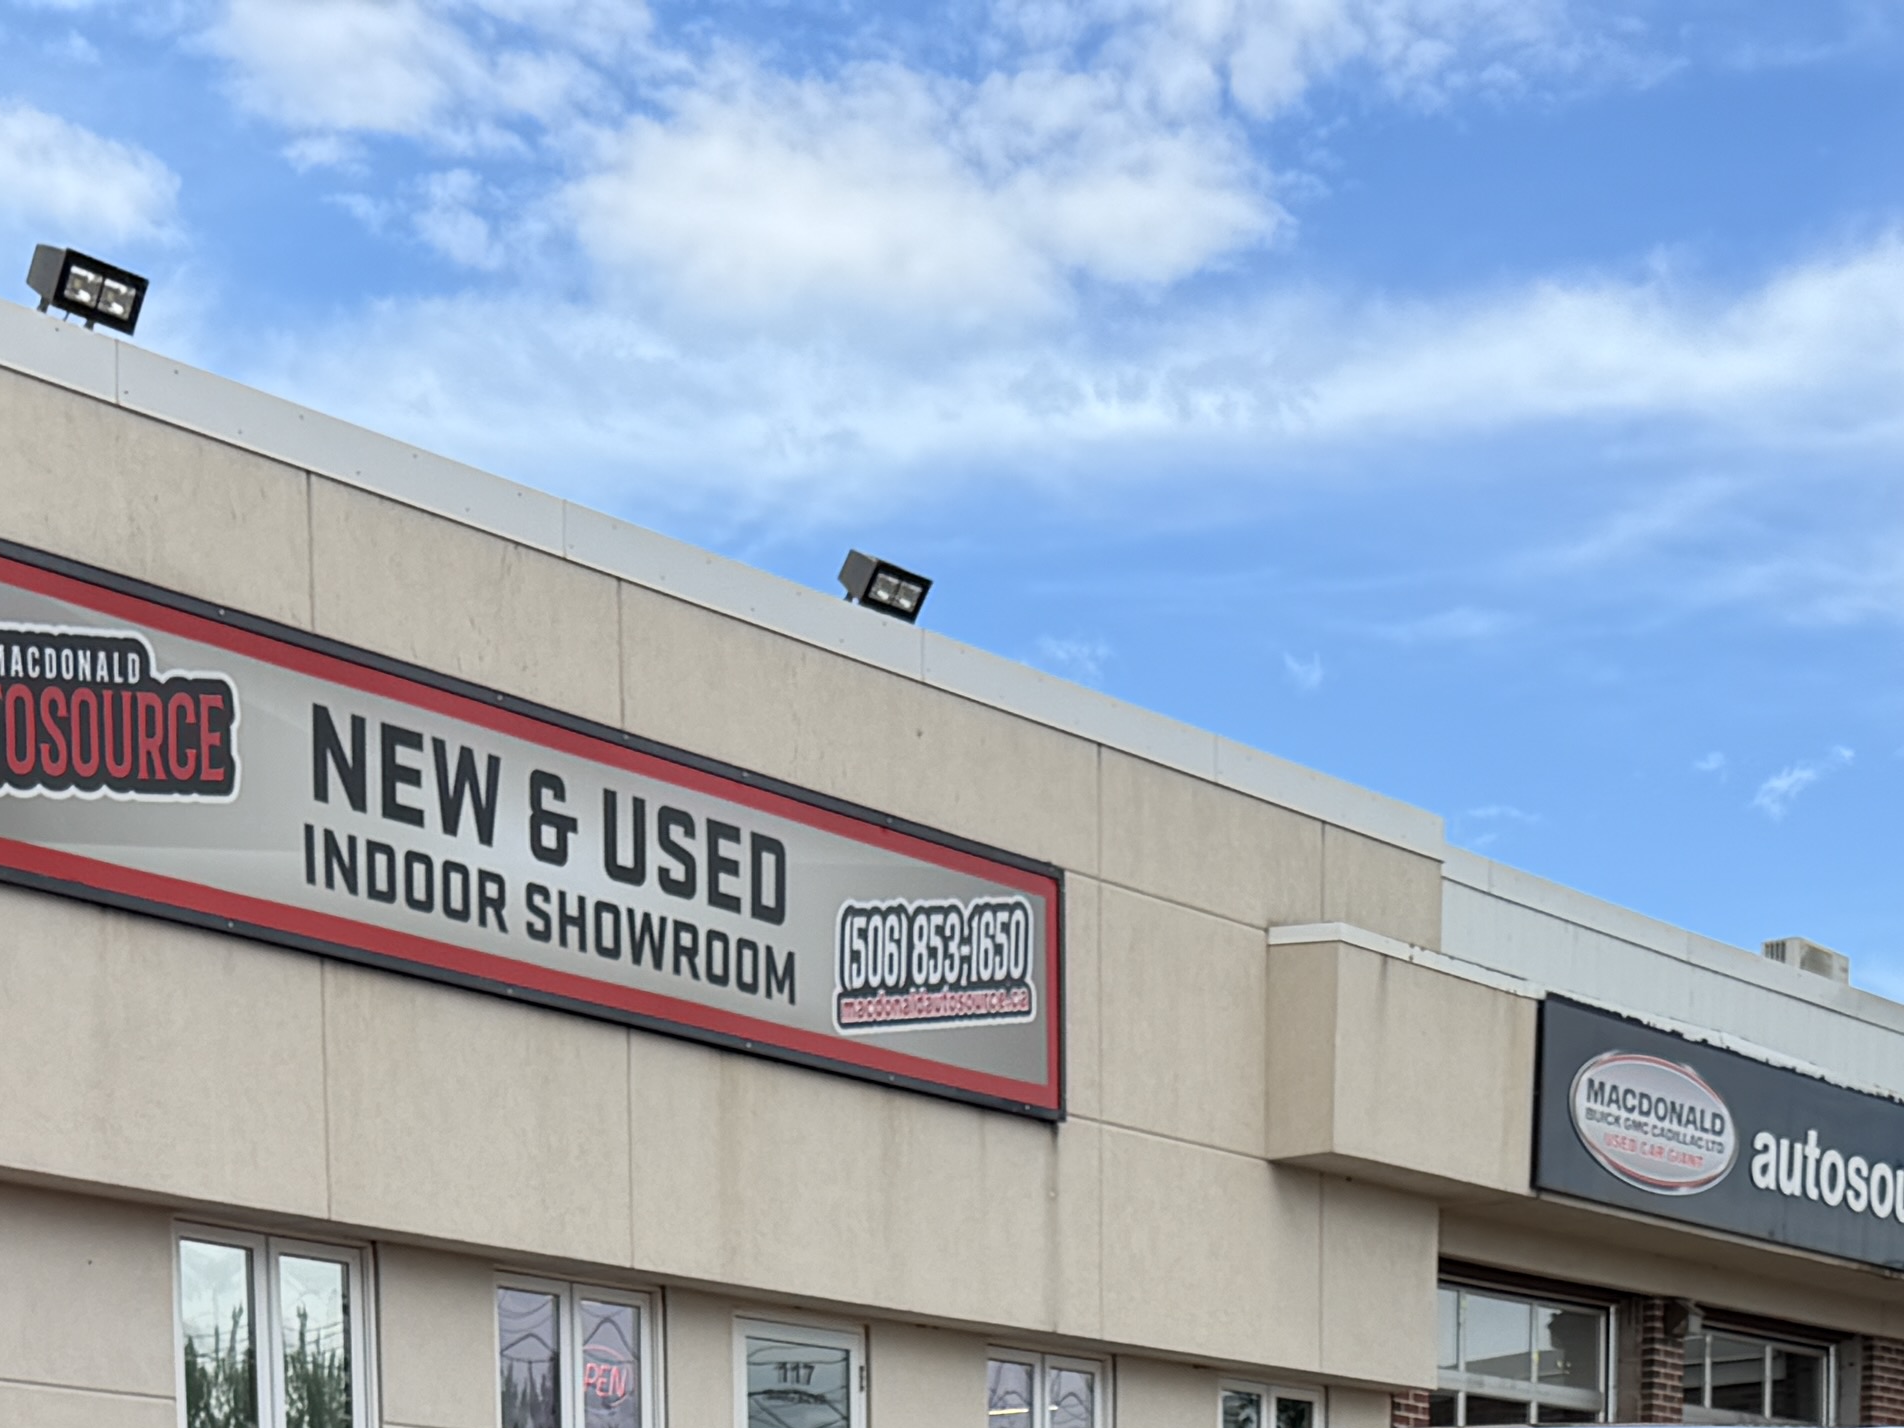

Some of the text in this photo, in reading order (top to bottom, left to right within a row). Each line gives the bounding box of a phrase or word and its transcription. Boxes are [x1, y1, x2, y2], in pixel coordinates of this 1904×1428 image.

[312, 701, 786, 927] NEW & USED
[304, 823, 796, 1006] INDOOR SHOWROOM
[844, 908, 1026, 991] (506) 853-1650
[1585, 1107, 1621, 1128] BUICK
[1623, 1117, 1649, 1135] GMC
[1651, 1124, 1704, 1150] CADILLAC
[1586, 1077, 1726, 1137] MACDONALD
[1604, 1132, 1638, 1152] USED
[1640, 1141, 1665, 1158] CAR
[584, 1362, 628, 1398] PEN
